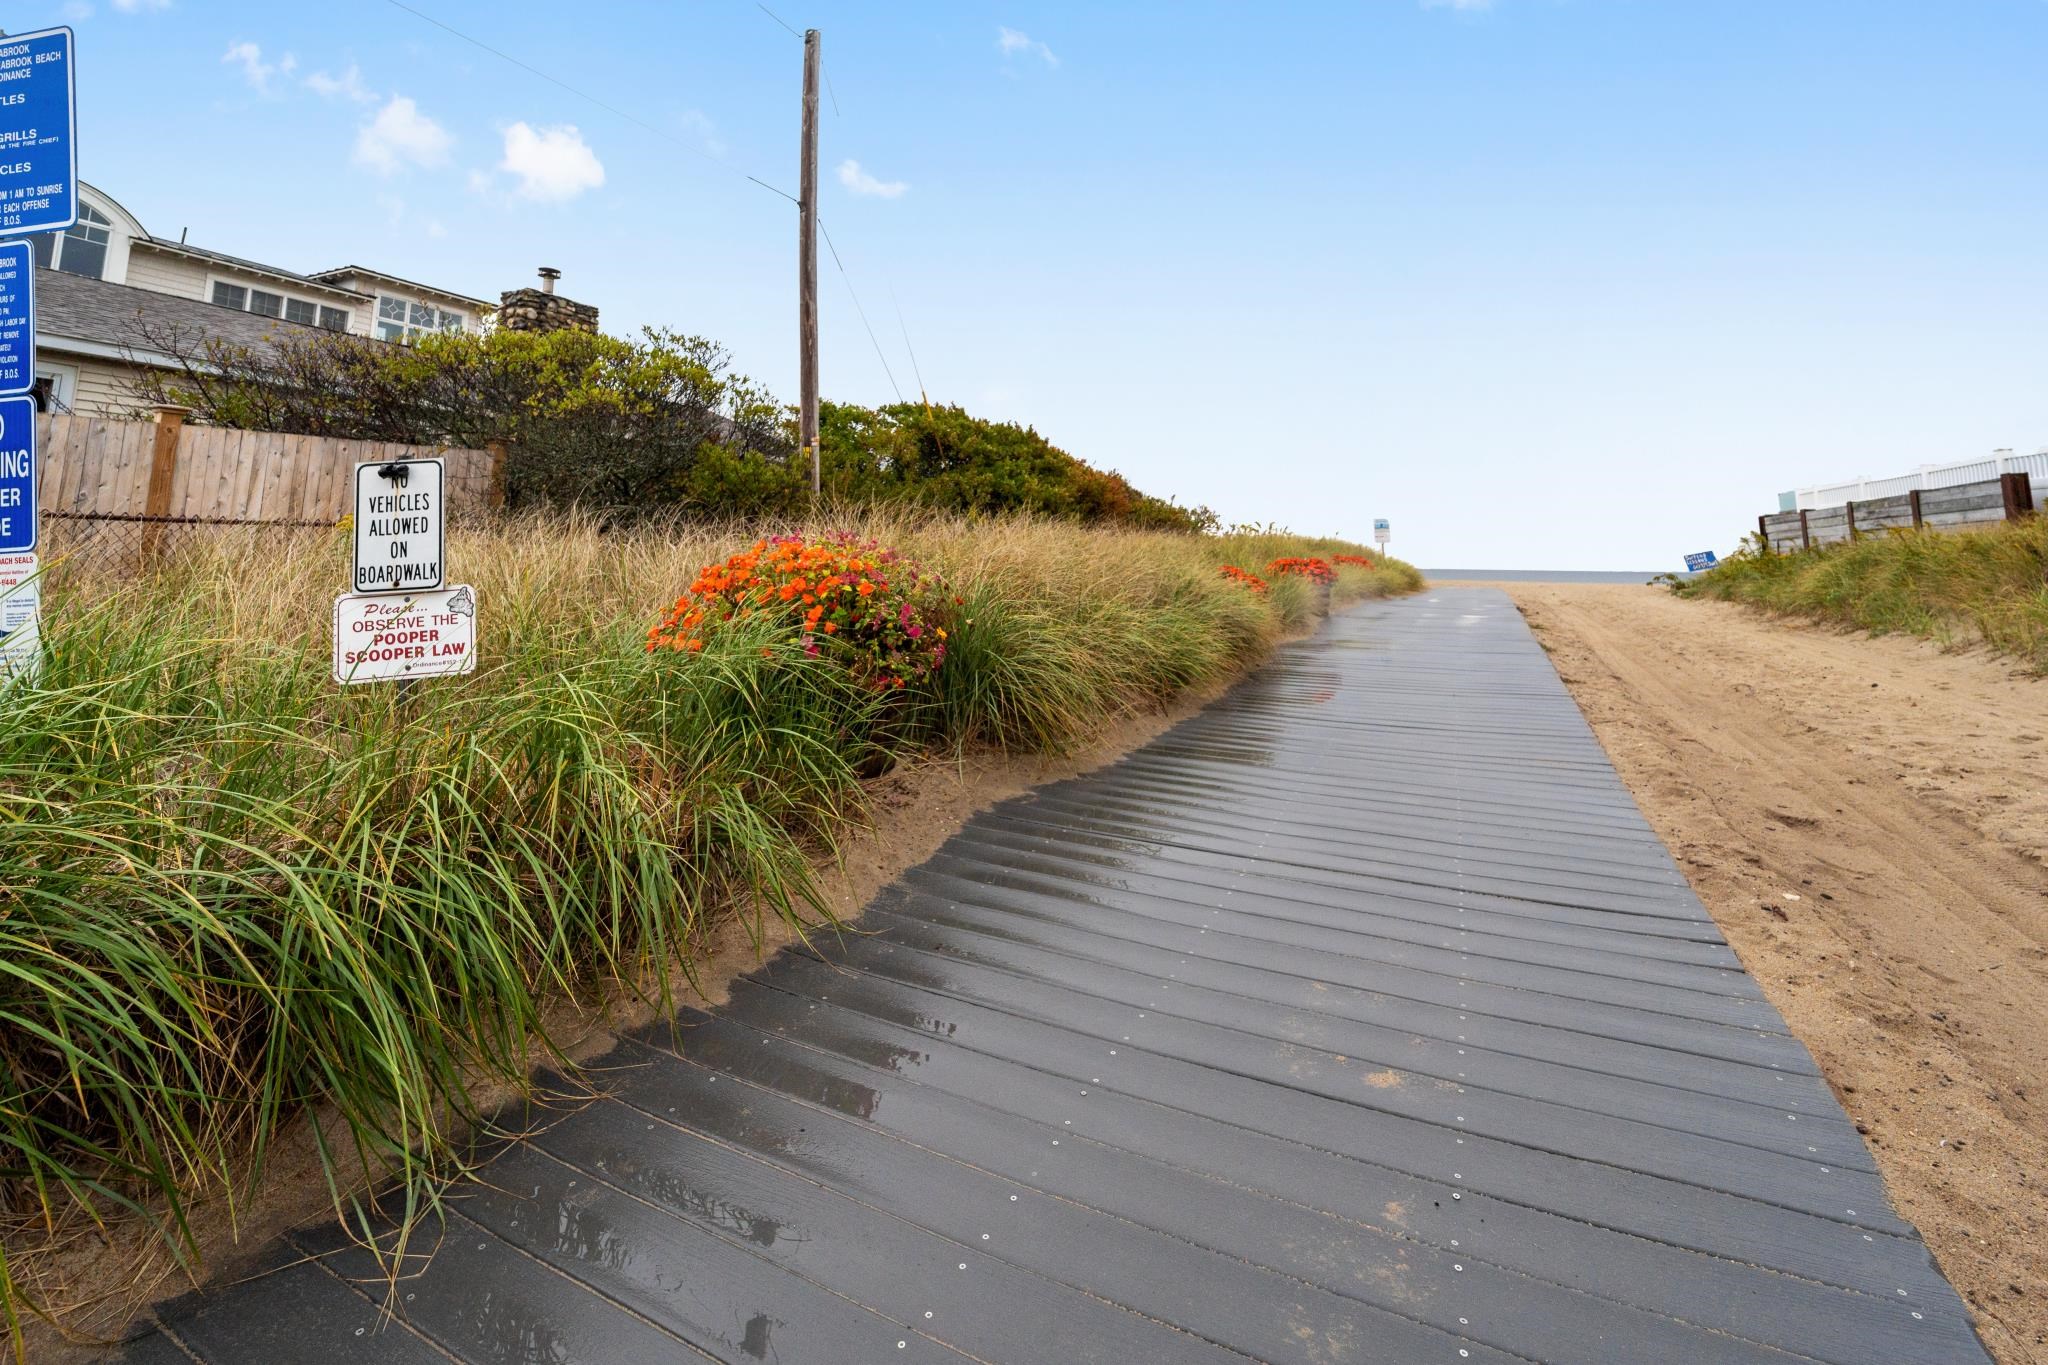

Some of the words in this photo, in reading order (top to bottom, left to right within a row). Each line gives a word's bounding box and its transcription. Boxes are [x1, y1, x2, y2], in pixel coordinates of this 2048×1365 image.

[35, 51, 61, 64] BEACH
[15, 188, 24, 198] AM
[27, 187, 34, 197] TO
[37, 184, 63, 196] SUNRISE
[4, 202, 20, 213] EACH
[22, 199, 50, 211] OFFENSE
[369, 493, 430, 514] VEHICLES
[369, 517, 428, 537] ALLOWED
[390, 541, 408, 559] ON
[15, 556, 34, 564] SEALS
[359, 562, 438, 584] BOARDWALK
[352, 616, 425, 633] OBSERVE
[431, 614, 459, 626] THE
[373, 629, 440, 646] POOPER
[345, 646, 425, 664] SCOOPER
[432, 643, 466, 657] LAW
